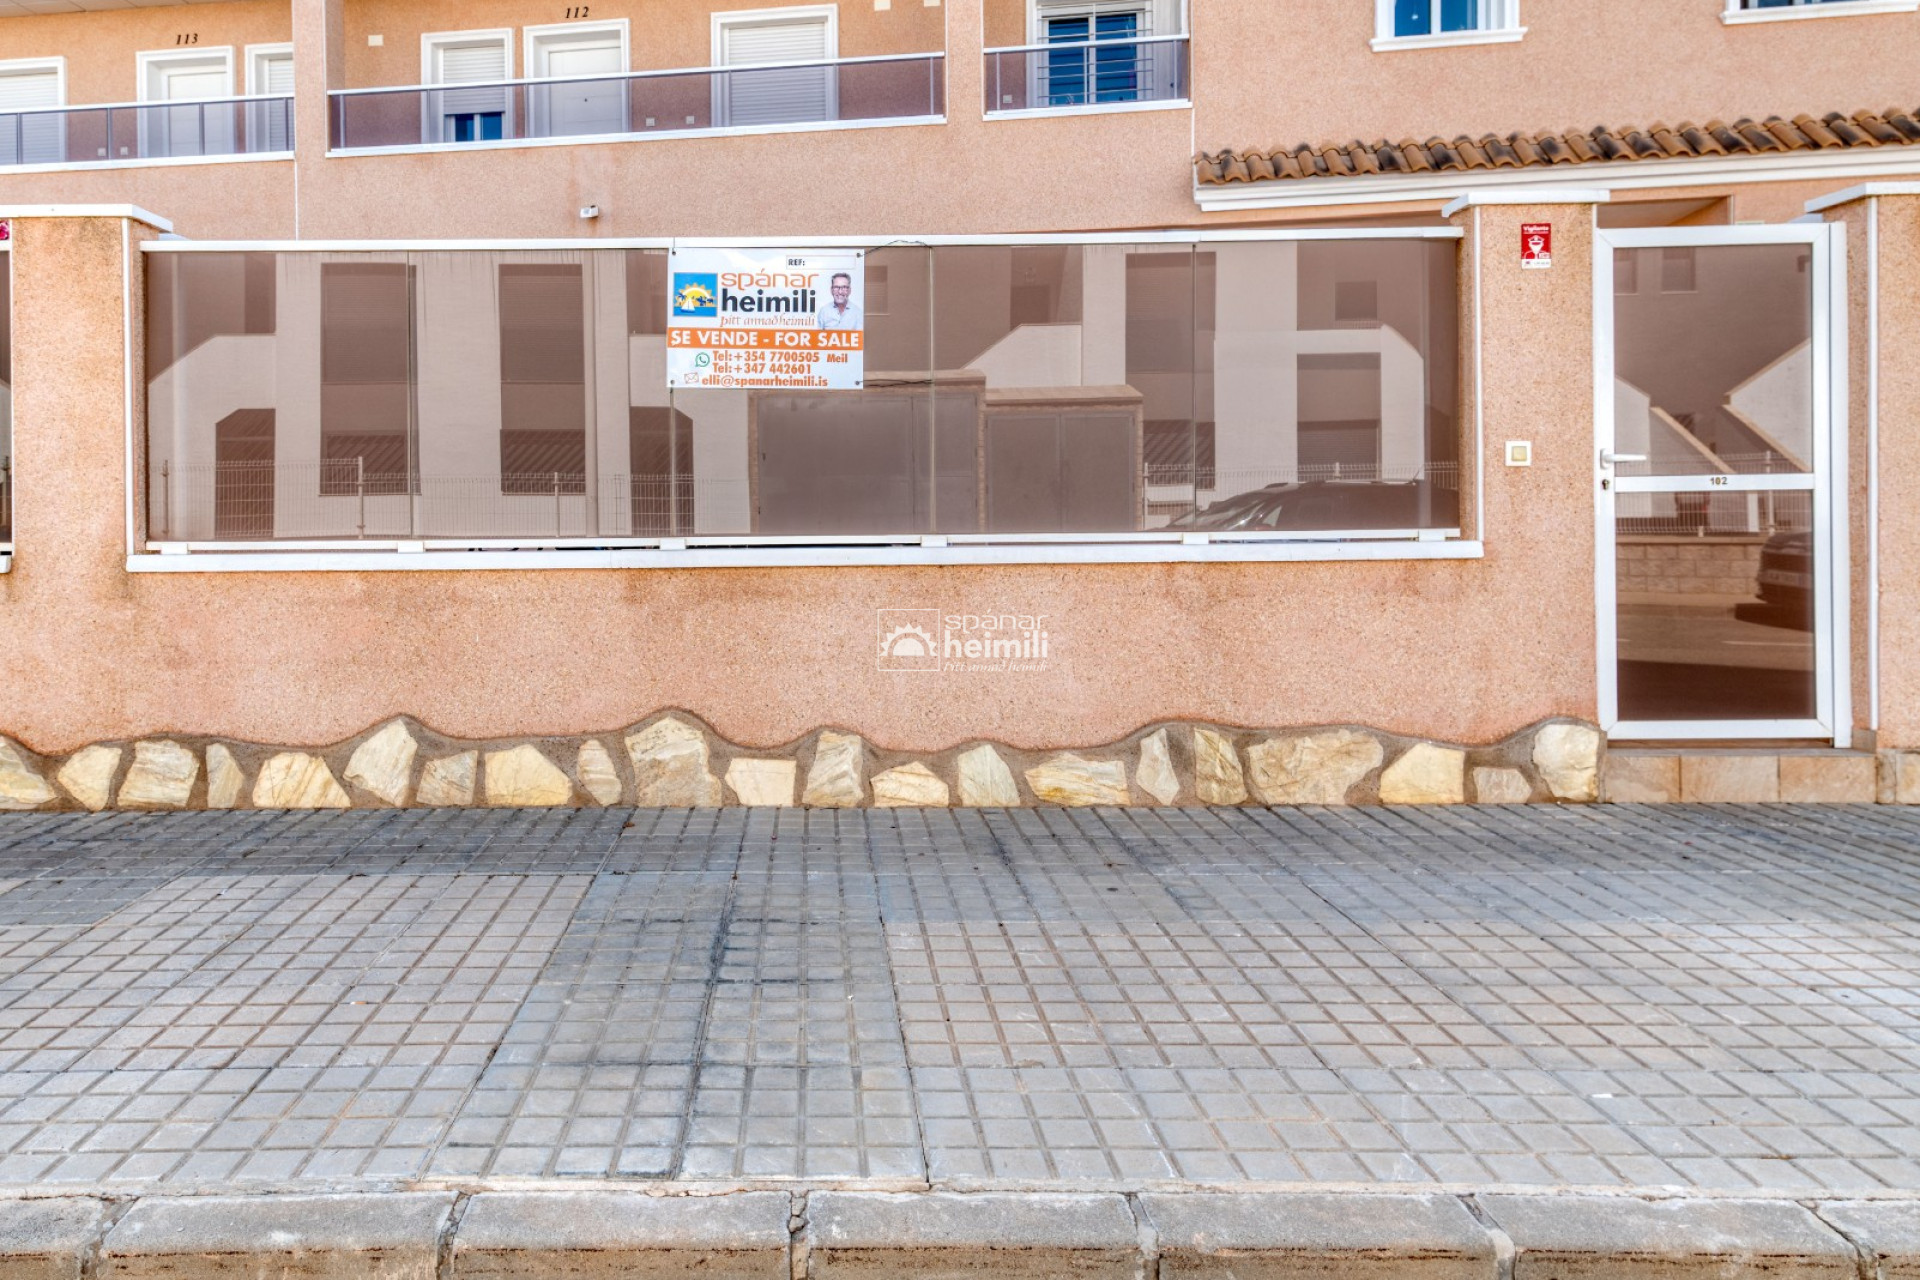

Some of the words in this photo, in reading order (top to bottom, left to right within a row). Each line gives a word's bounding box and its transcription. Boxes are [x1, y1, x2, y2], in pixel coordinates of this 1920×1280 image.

[565, 6, 589, 18] 112
[176, 33, 198, 45] 113
[788, 258, 805, 266] REF:
[721, 268, 820, 290] spánar
[721, 288, 816, 313] heimili
[671, 330, 691, 345] SE
[697, 331, 758, 346] VENDE
[774, 332, 811, 347] FOR
[817, 333, 859, 347] SALE
[769, 351, 820, 363] 7700505
[769, 363, 811, 374] 442601
[702, 375, 828, 387] elli@spanarheimili.is
[1710, 476, 1728, 486] 102
